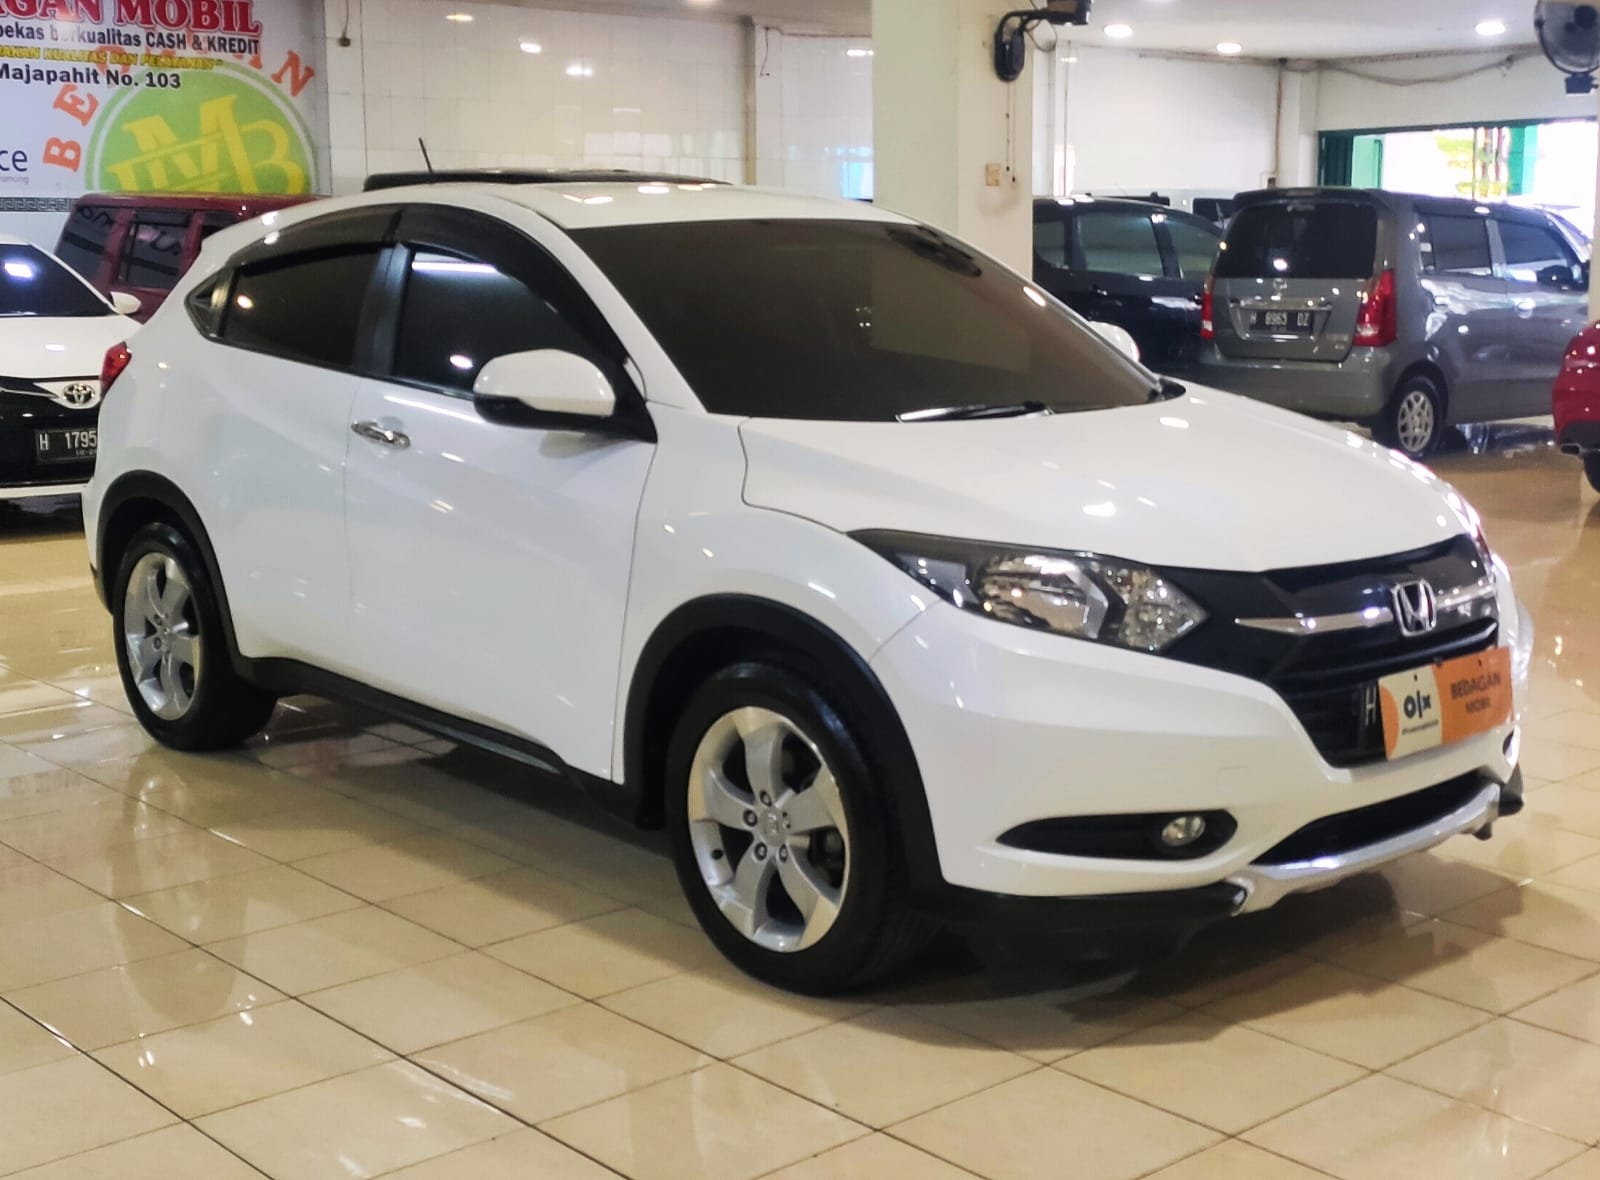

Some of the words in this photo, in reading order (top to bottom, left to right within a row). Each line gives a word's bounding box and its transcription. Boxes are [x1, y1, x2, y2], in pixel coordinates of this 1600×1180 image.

[114, 0, 262, 35] MOBIL
[49, 24, 141, 47] bkualitas
[145, 32, 186, 50] CASH
[191, 35, 202, 50] &
[207, 36, 260, 55] KREDIT
[106, 70, 139, 86] No.
[145, 71, 182, 88] 103
[40, 432, 49, 451] H
[65, 430, 97, 449] 1795
